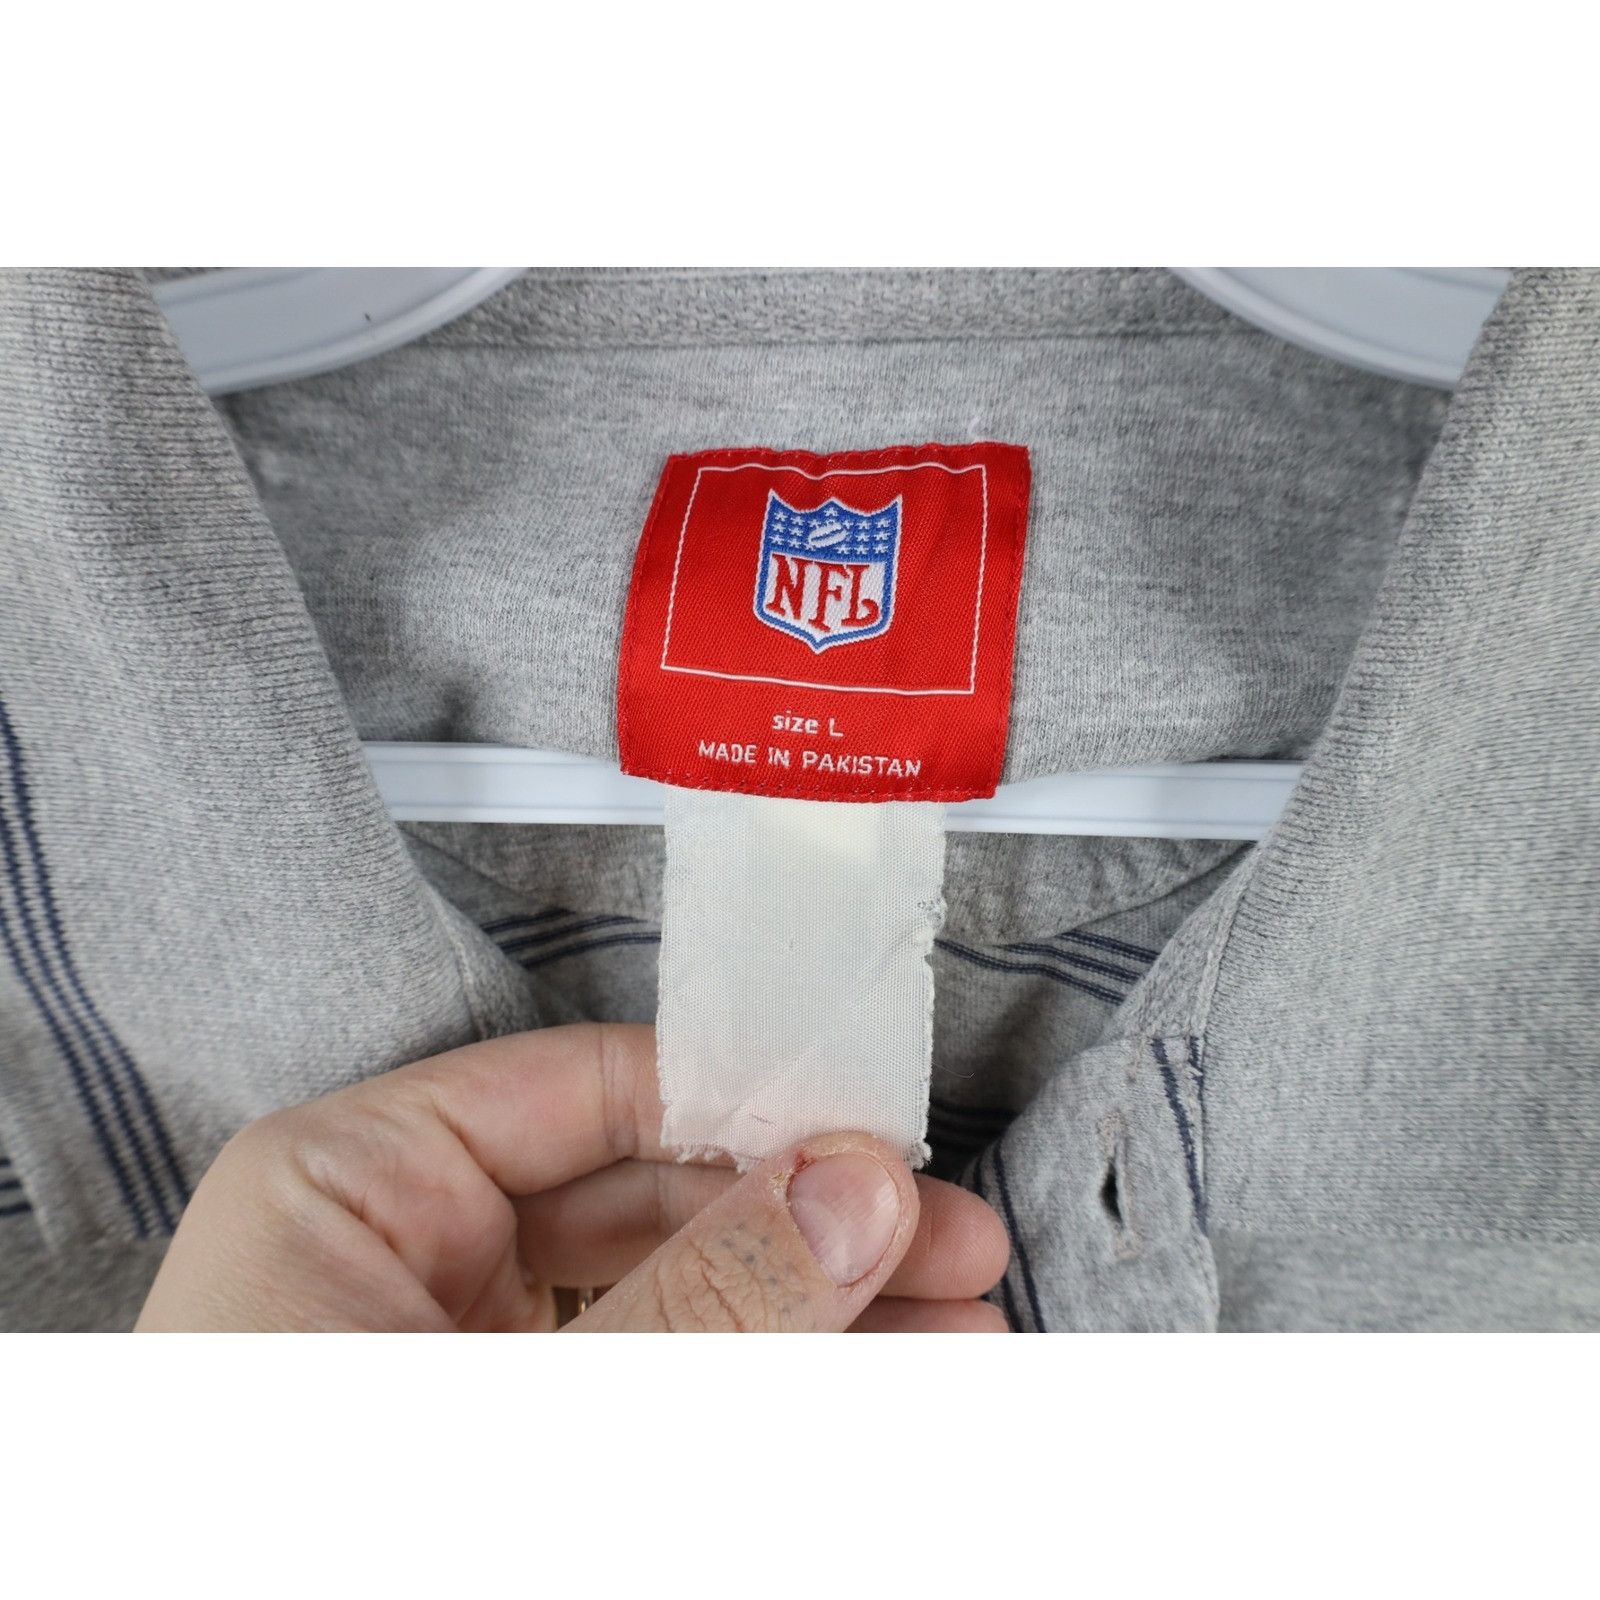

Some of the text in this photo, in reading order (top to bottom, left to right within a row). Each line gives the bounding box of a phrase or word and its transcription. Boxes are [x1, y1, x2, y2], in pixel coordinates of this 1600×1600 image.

[766, 553, 880, 632] NFL
[772, 710, 844, 737] size L
[698, 740, 921, 777] MADE IN PAKISTAN
